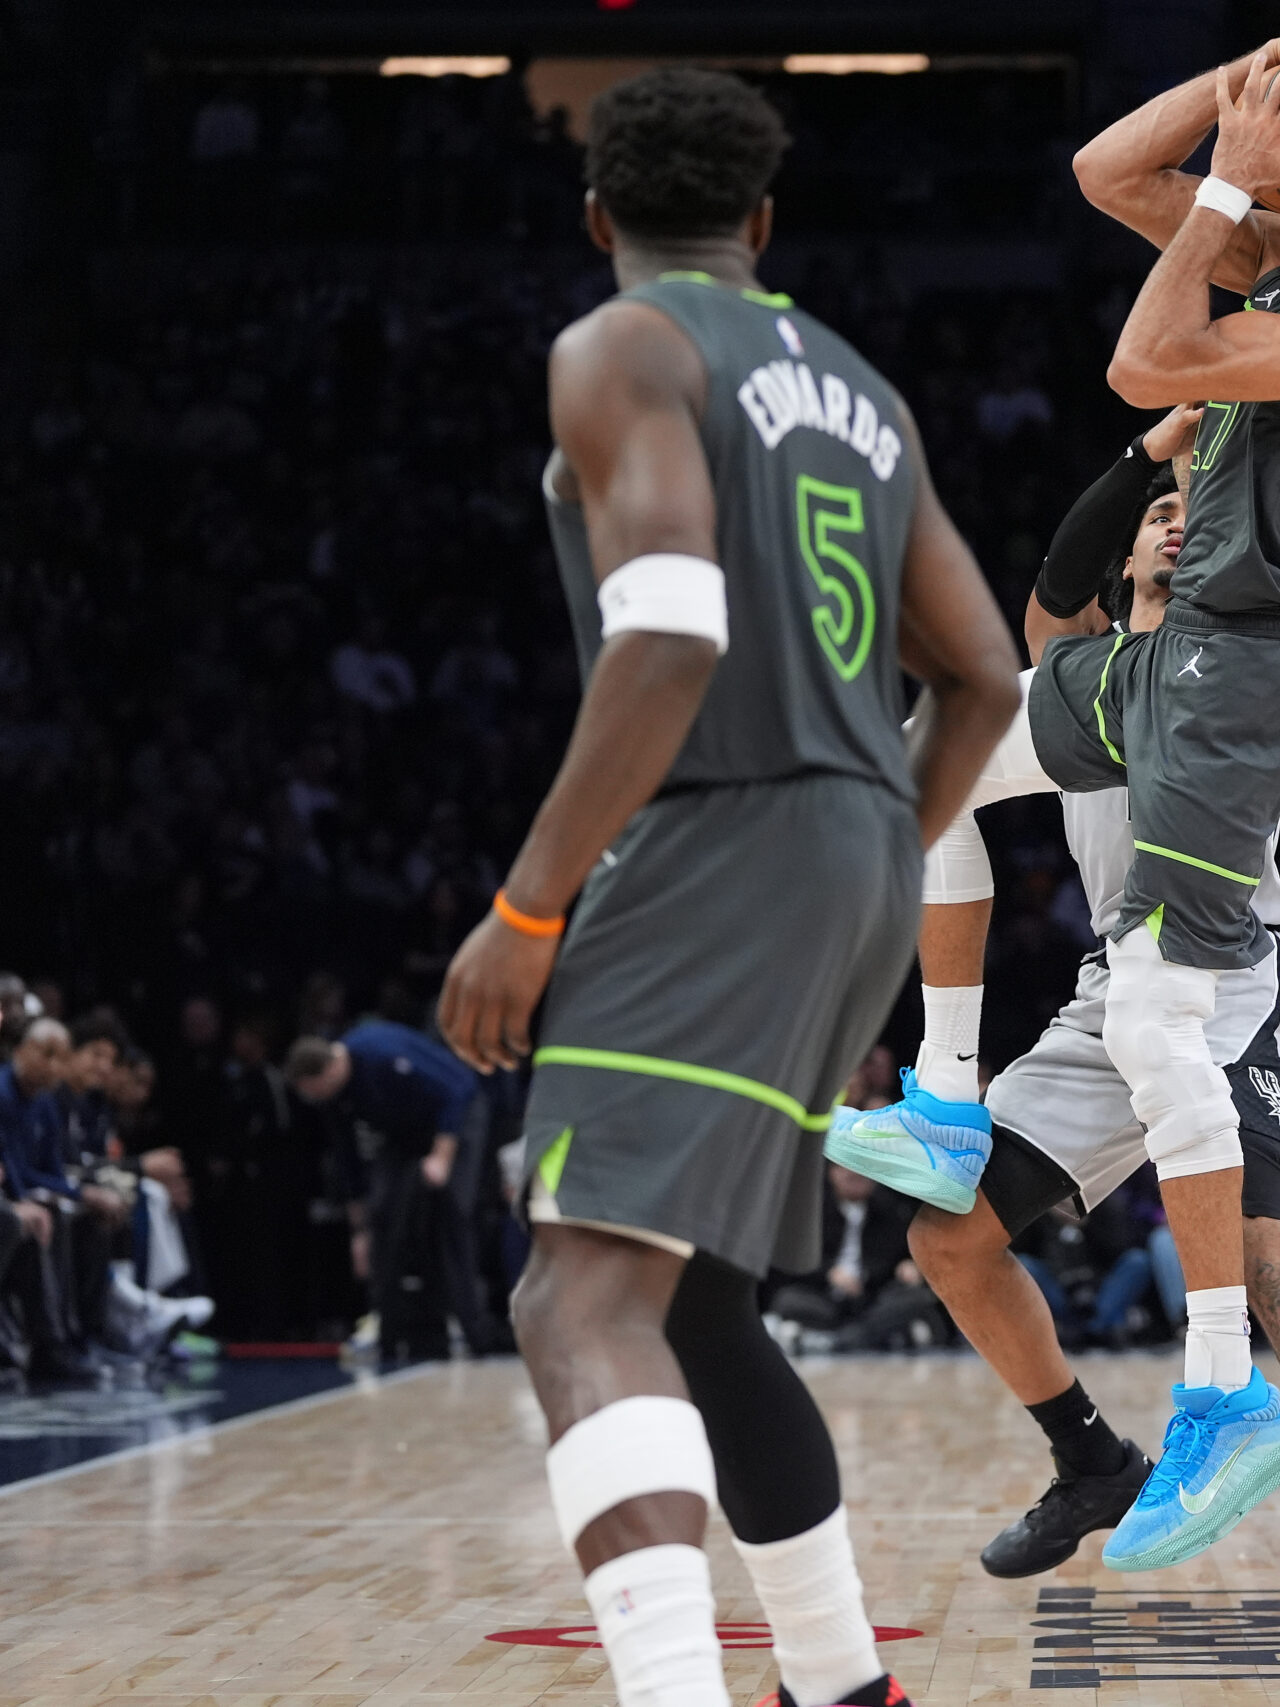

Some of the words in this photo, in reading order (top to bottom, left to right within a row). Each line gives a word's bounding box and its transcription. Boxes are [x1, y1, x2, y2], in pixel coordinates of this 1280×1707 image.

[737, 358, 902, 482] EDWARDS
[1190, 400, 1241, 471] 7
[796, 472, 876, 682] 5
